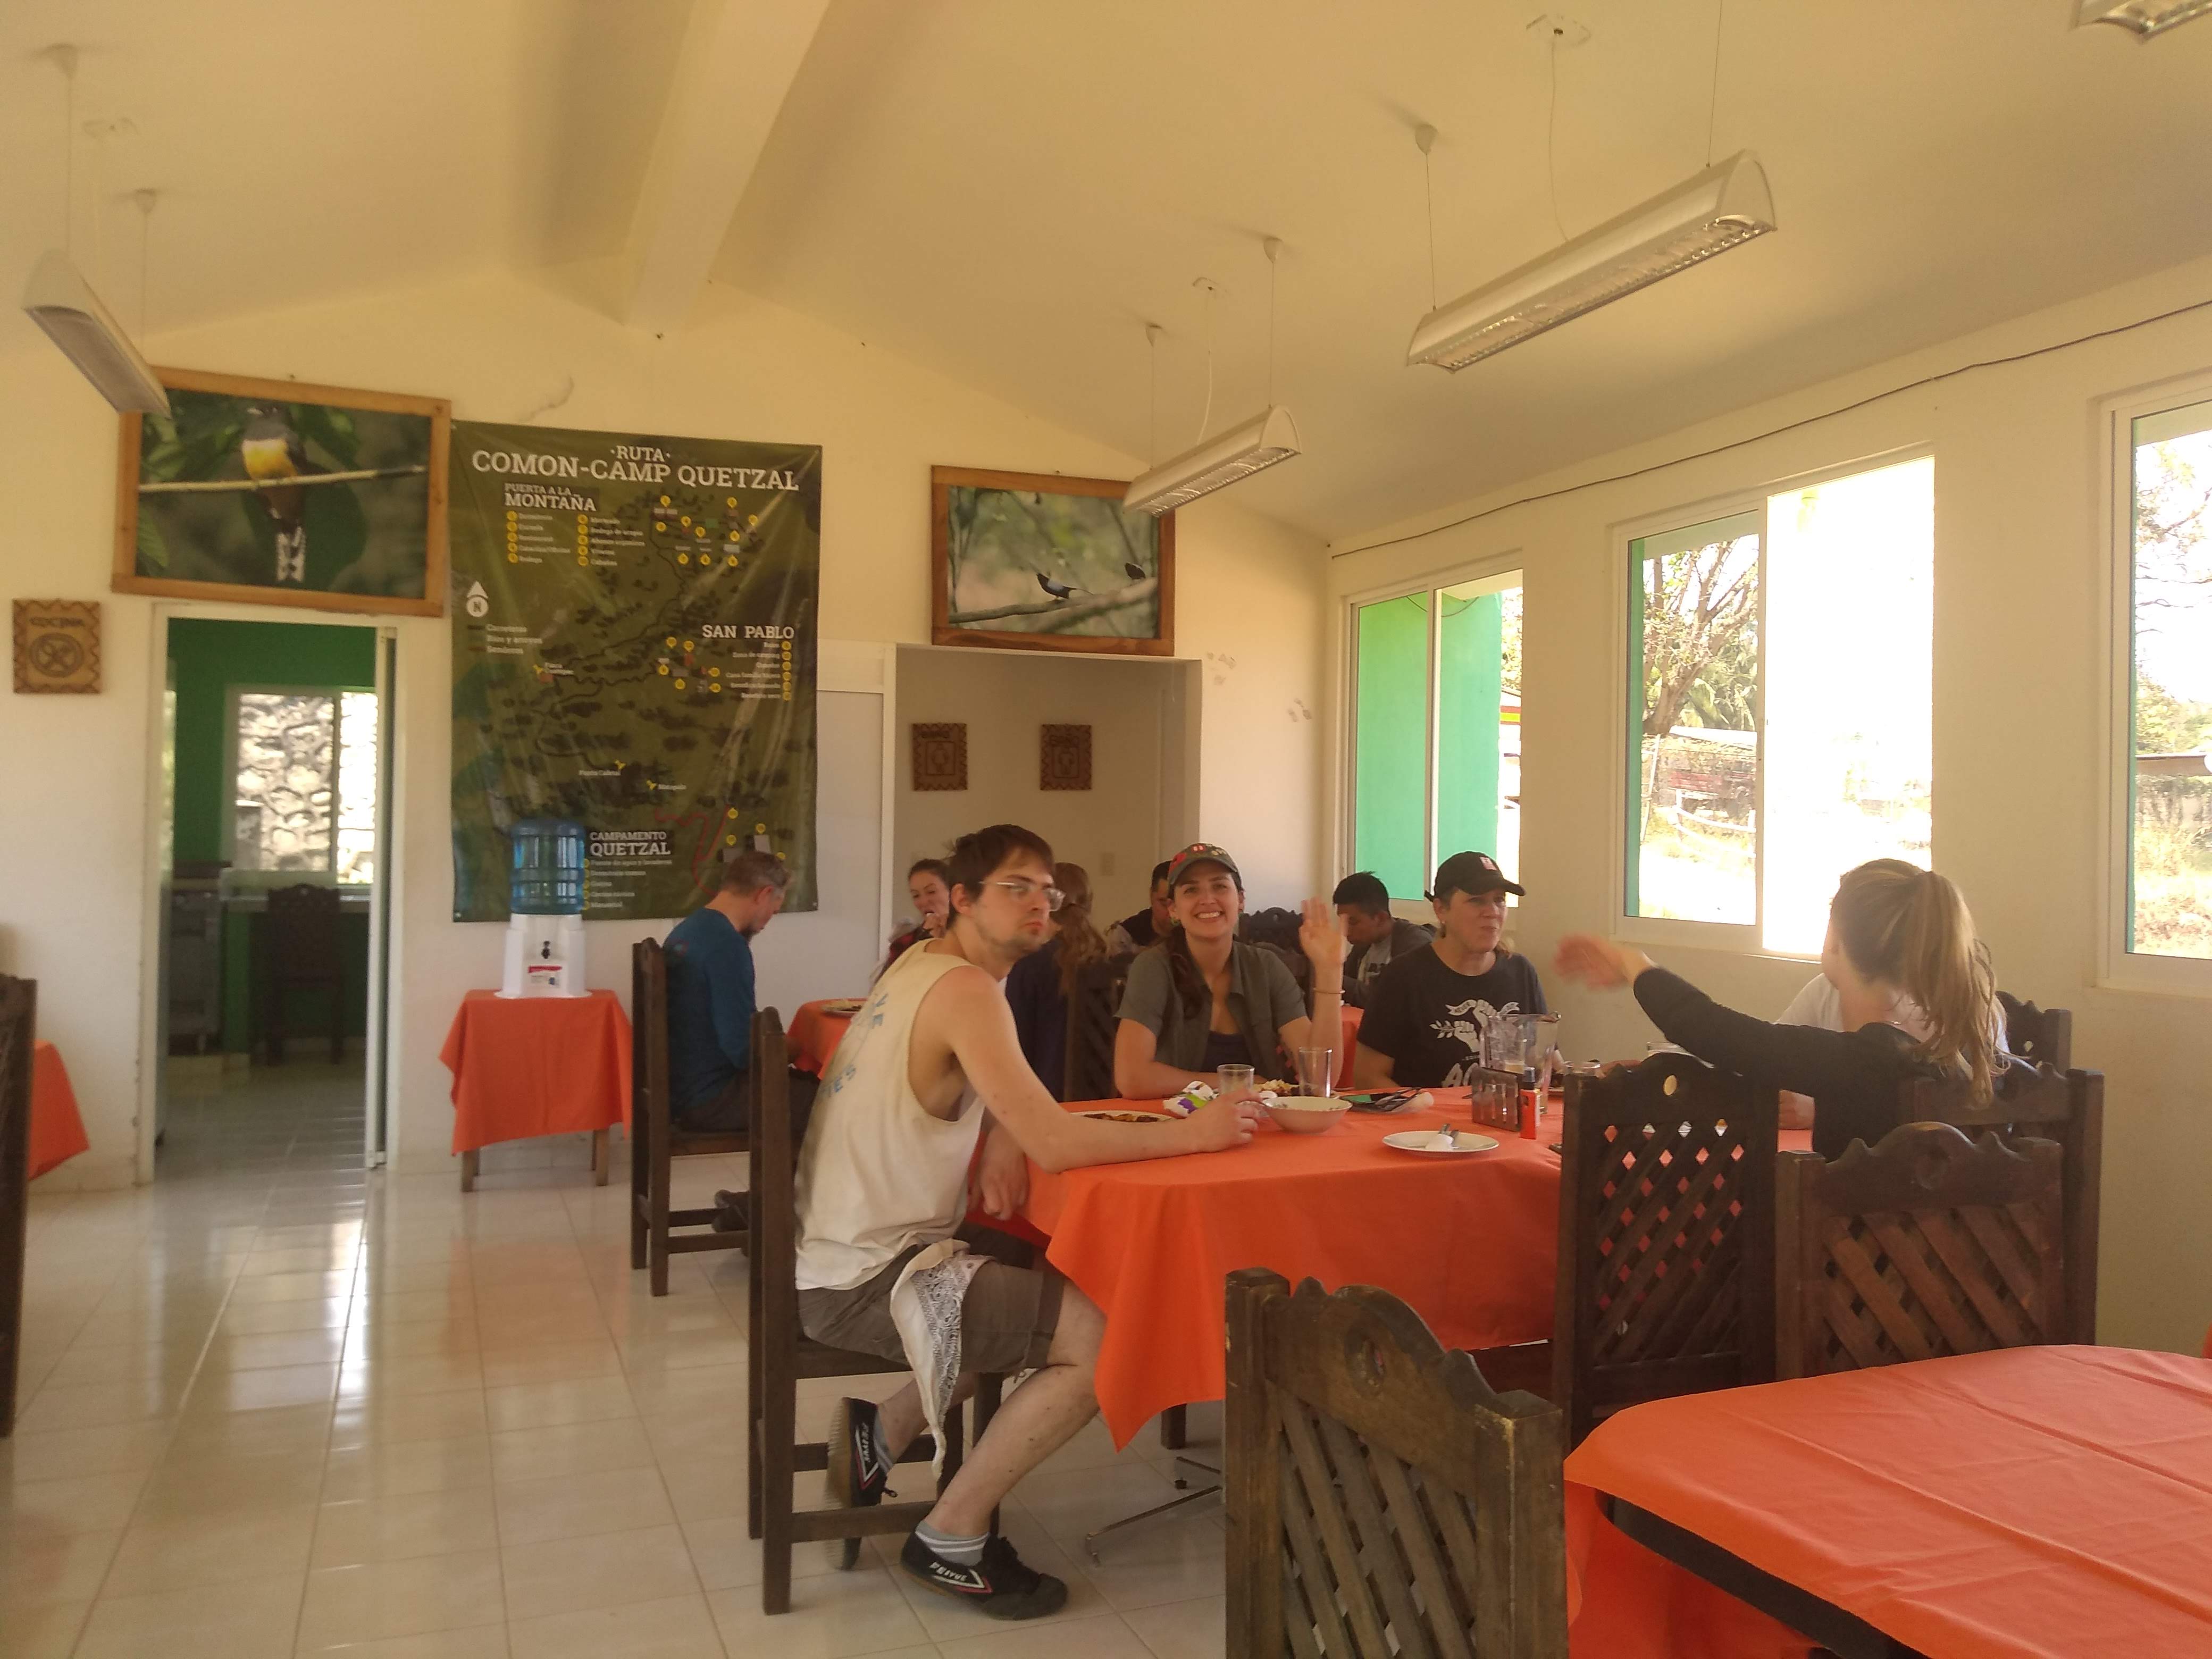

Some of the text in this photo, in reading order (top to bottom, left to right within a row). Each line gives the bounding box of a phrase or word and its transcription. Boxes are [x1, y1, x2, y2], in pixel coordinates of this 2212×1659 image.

[616, 445, 665, 462] RUTA
[472, 450, 799, 491] COMON-CAMP QUETZAL
[505, 482, 547, 494] PUERTA
[548, 486, 556, 495] A
[702, 624, 795, 639] SAN PABLO
[590, 831, 667, 840] CAMPAMENTO
[590, 842, 672, 857] QUETZAL
